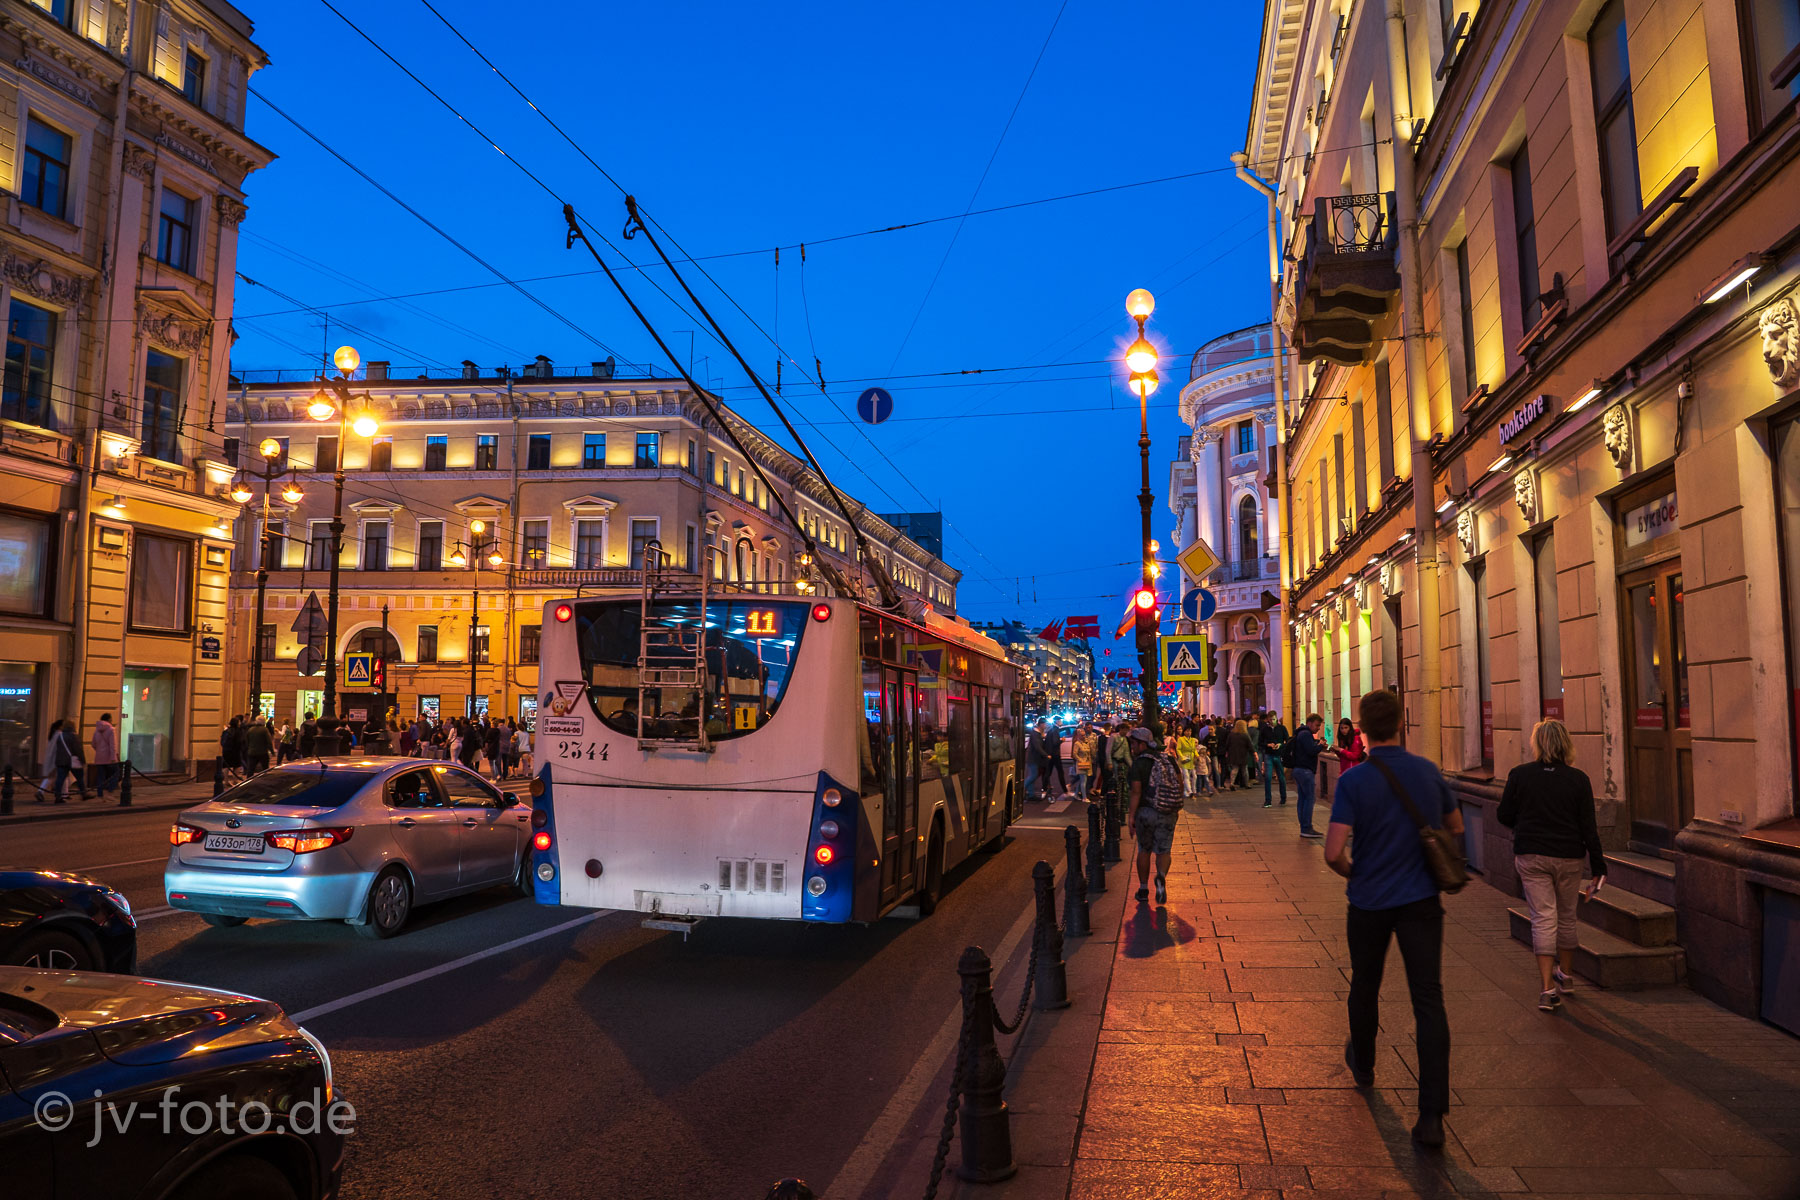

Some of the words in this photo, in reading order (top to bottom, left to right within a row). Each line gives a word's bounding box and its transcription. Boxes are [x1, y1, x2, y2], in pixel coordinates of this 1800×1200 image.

[1499, 395, 1543, 445] bookstore
[1638, 505, 1678, 533] БУКВОе
[747, 611, 777, 633] 11
[549, 726, 581, 734] 600-44-00
[558, 741, 609, 761] 2344
[247, 838, 261, 847] 178
